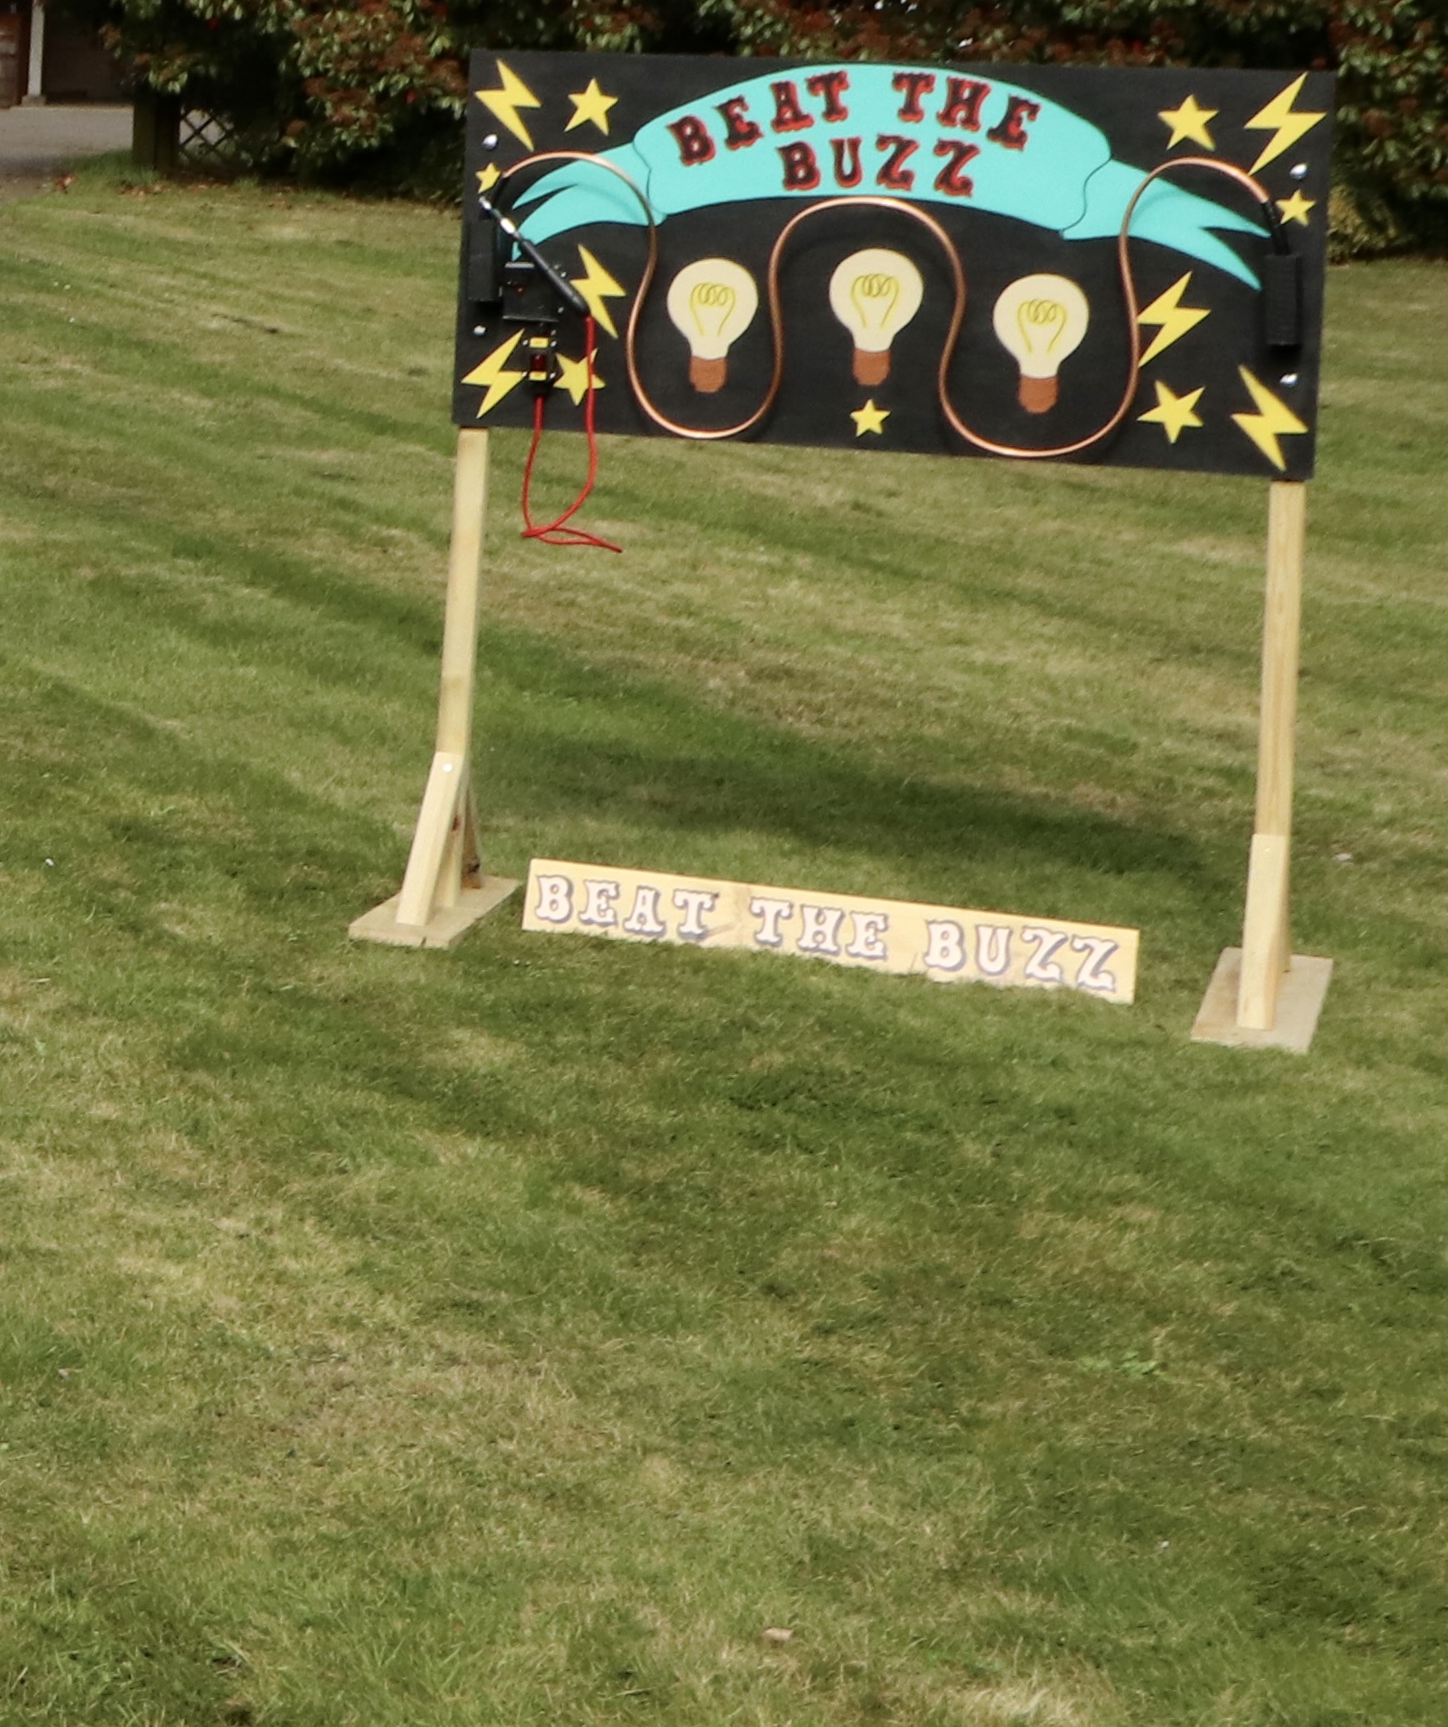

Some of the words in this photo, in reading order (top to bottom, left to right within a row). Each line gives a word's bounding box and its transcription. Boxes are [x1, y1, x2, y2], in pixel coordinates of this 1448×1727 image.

[666, 71, 851, 167] BEAT
[892, 71, 1040, 151] THE
[777, 135, 982, 198] BUZZ
[534, 873, 719, 941] BEAT
[750, 897, 889, 962] THE
[923, 918, 1120, 993] BUZZ
